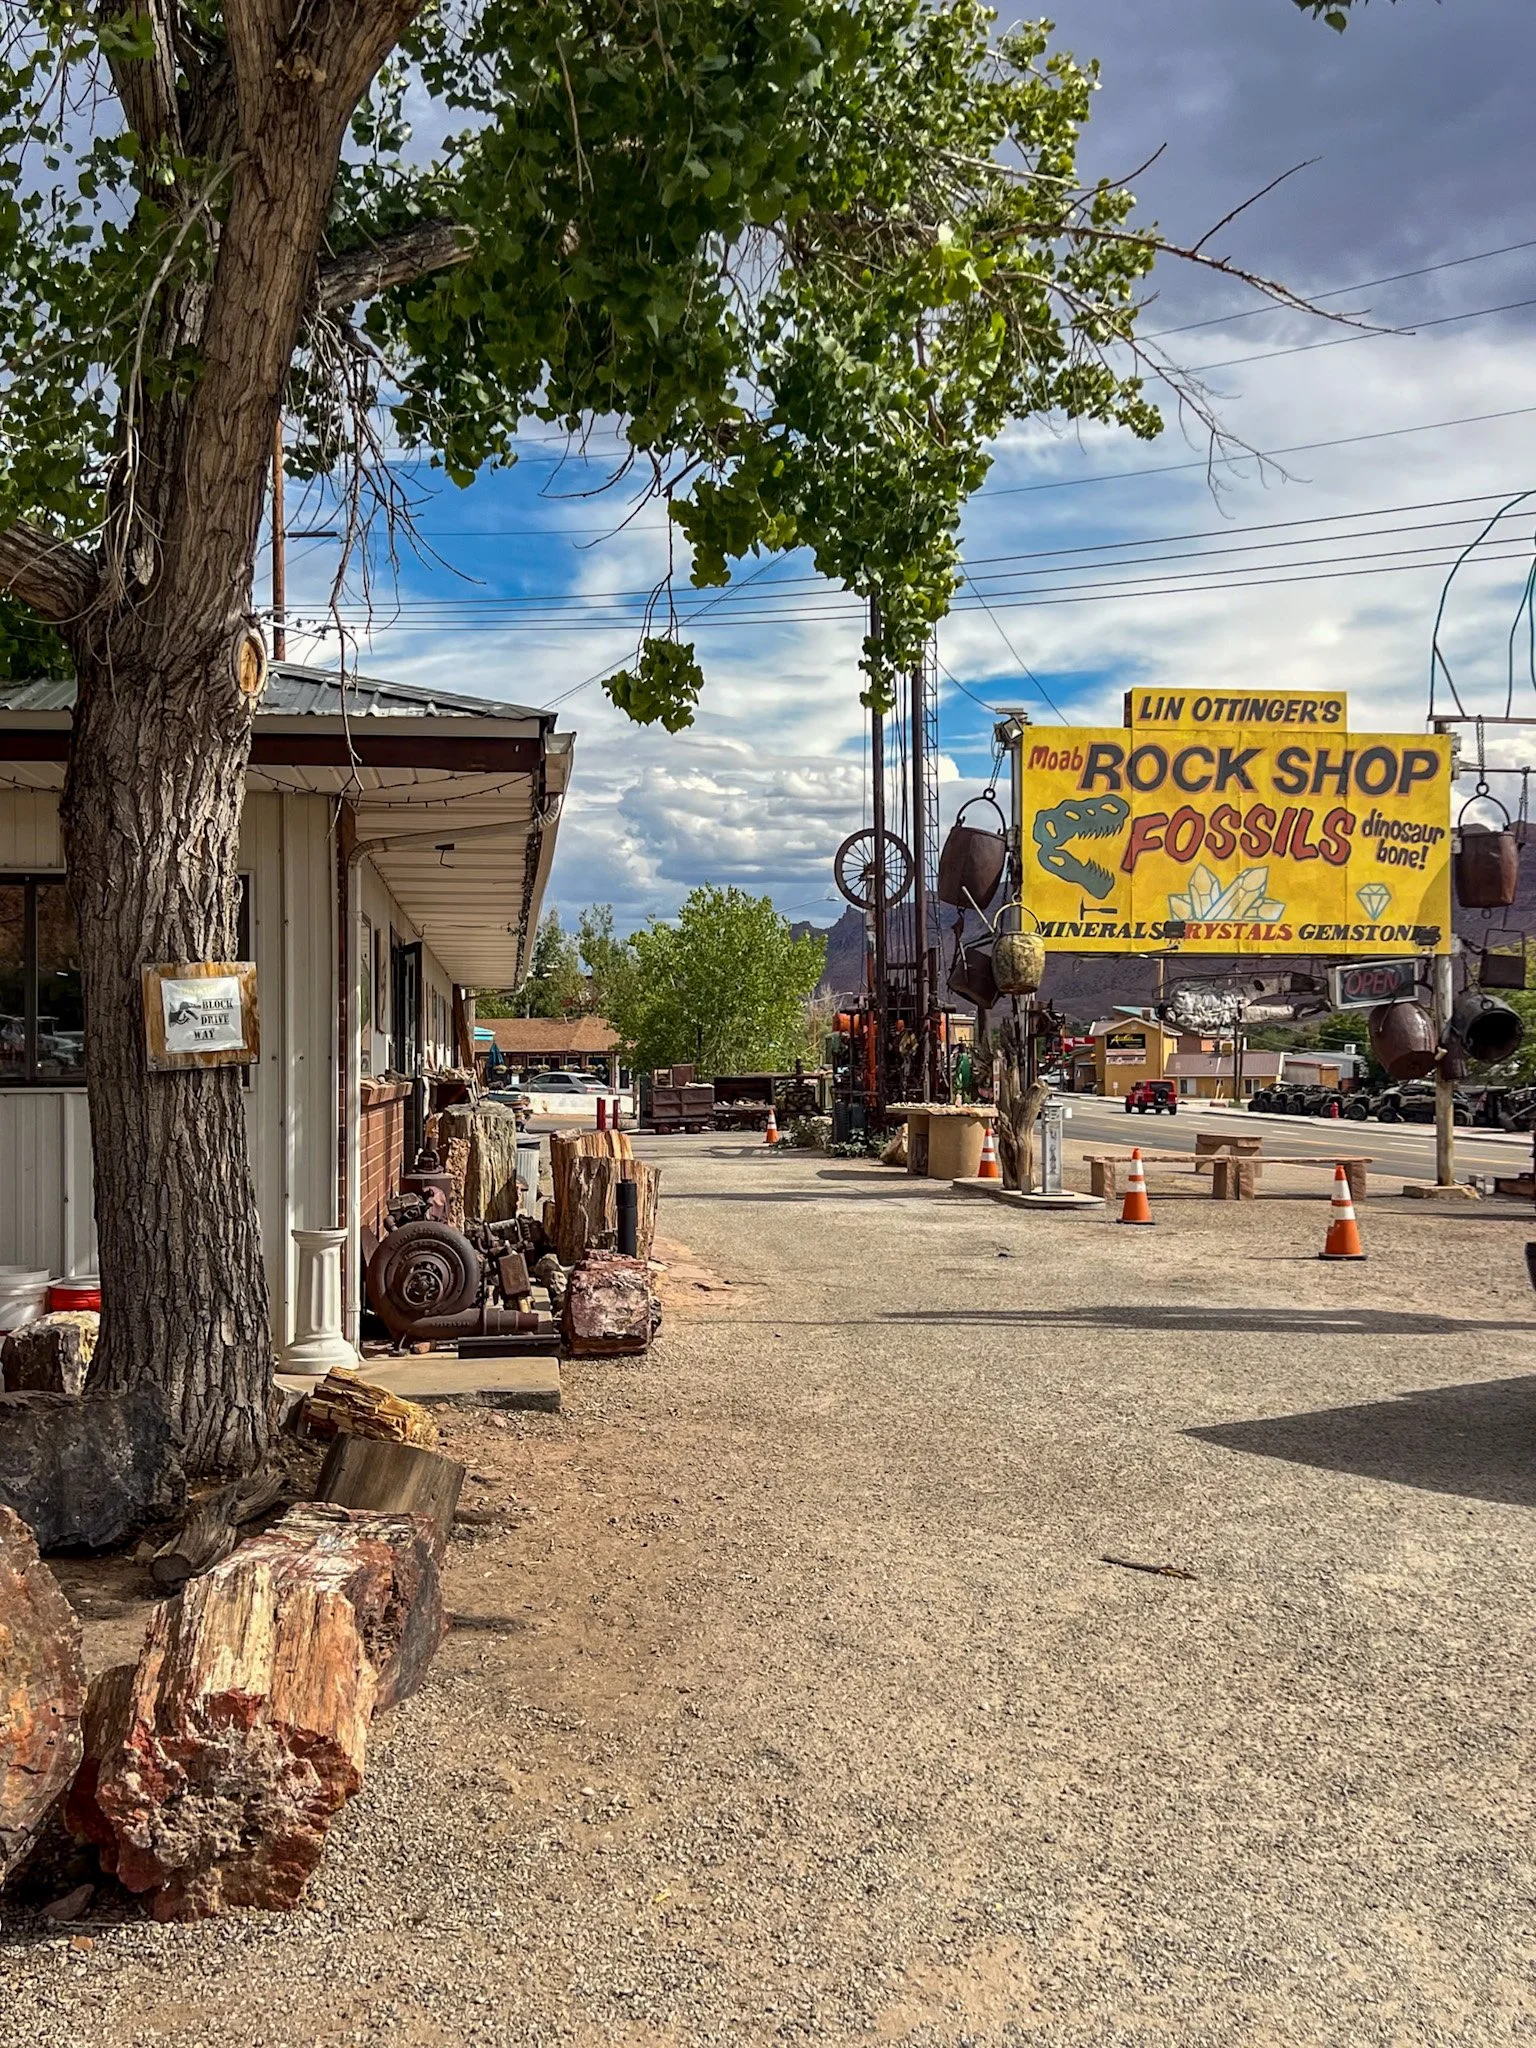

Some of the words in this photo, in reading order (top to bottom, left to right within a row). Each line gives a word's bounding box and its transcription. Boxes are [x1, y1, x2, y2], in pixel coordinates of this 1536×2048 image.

[1139, 696, 1184, 721] LIN
[1191, 698, 1342, 723] OTTINGER'S
[1029, 746, 1082, 771] Moab
[1079, 743, 1262, 793] ROCK
[1272, 747, 1440, 796] SHOP
[1121, 804, 1355, 872] FOSSILS
[1362, 810, 1446, 845] dinosaur
[1377, 841, 1428, 869] bone!
[1036, 921, 1164, 940] MINERALS
[1182, 922, 1292, 941] RYSTALS
[1345, 971, 1399, 995] OPEN
[202, 999, 233, 1010] BLOCK
[201, 1014, 229, 1026] DRIVE
[193, 1029, 215, 1041] WAY
